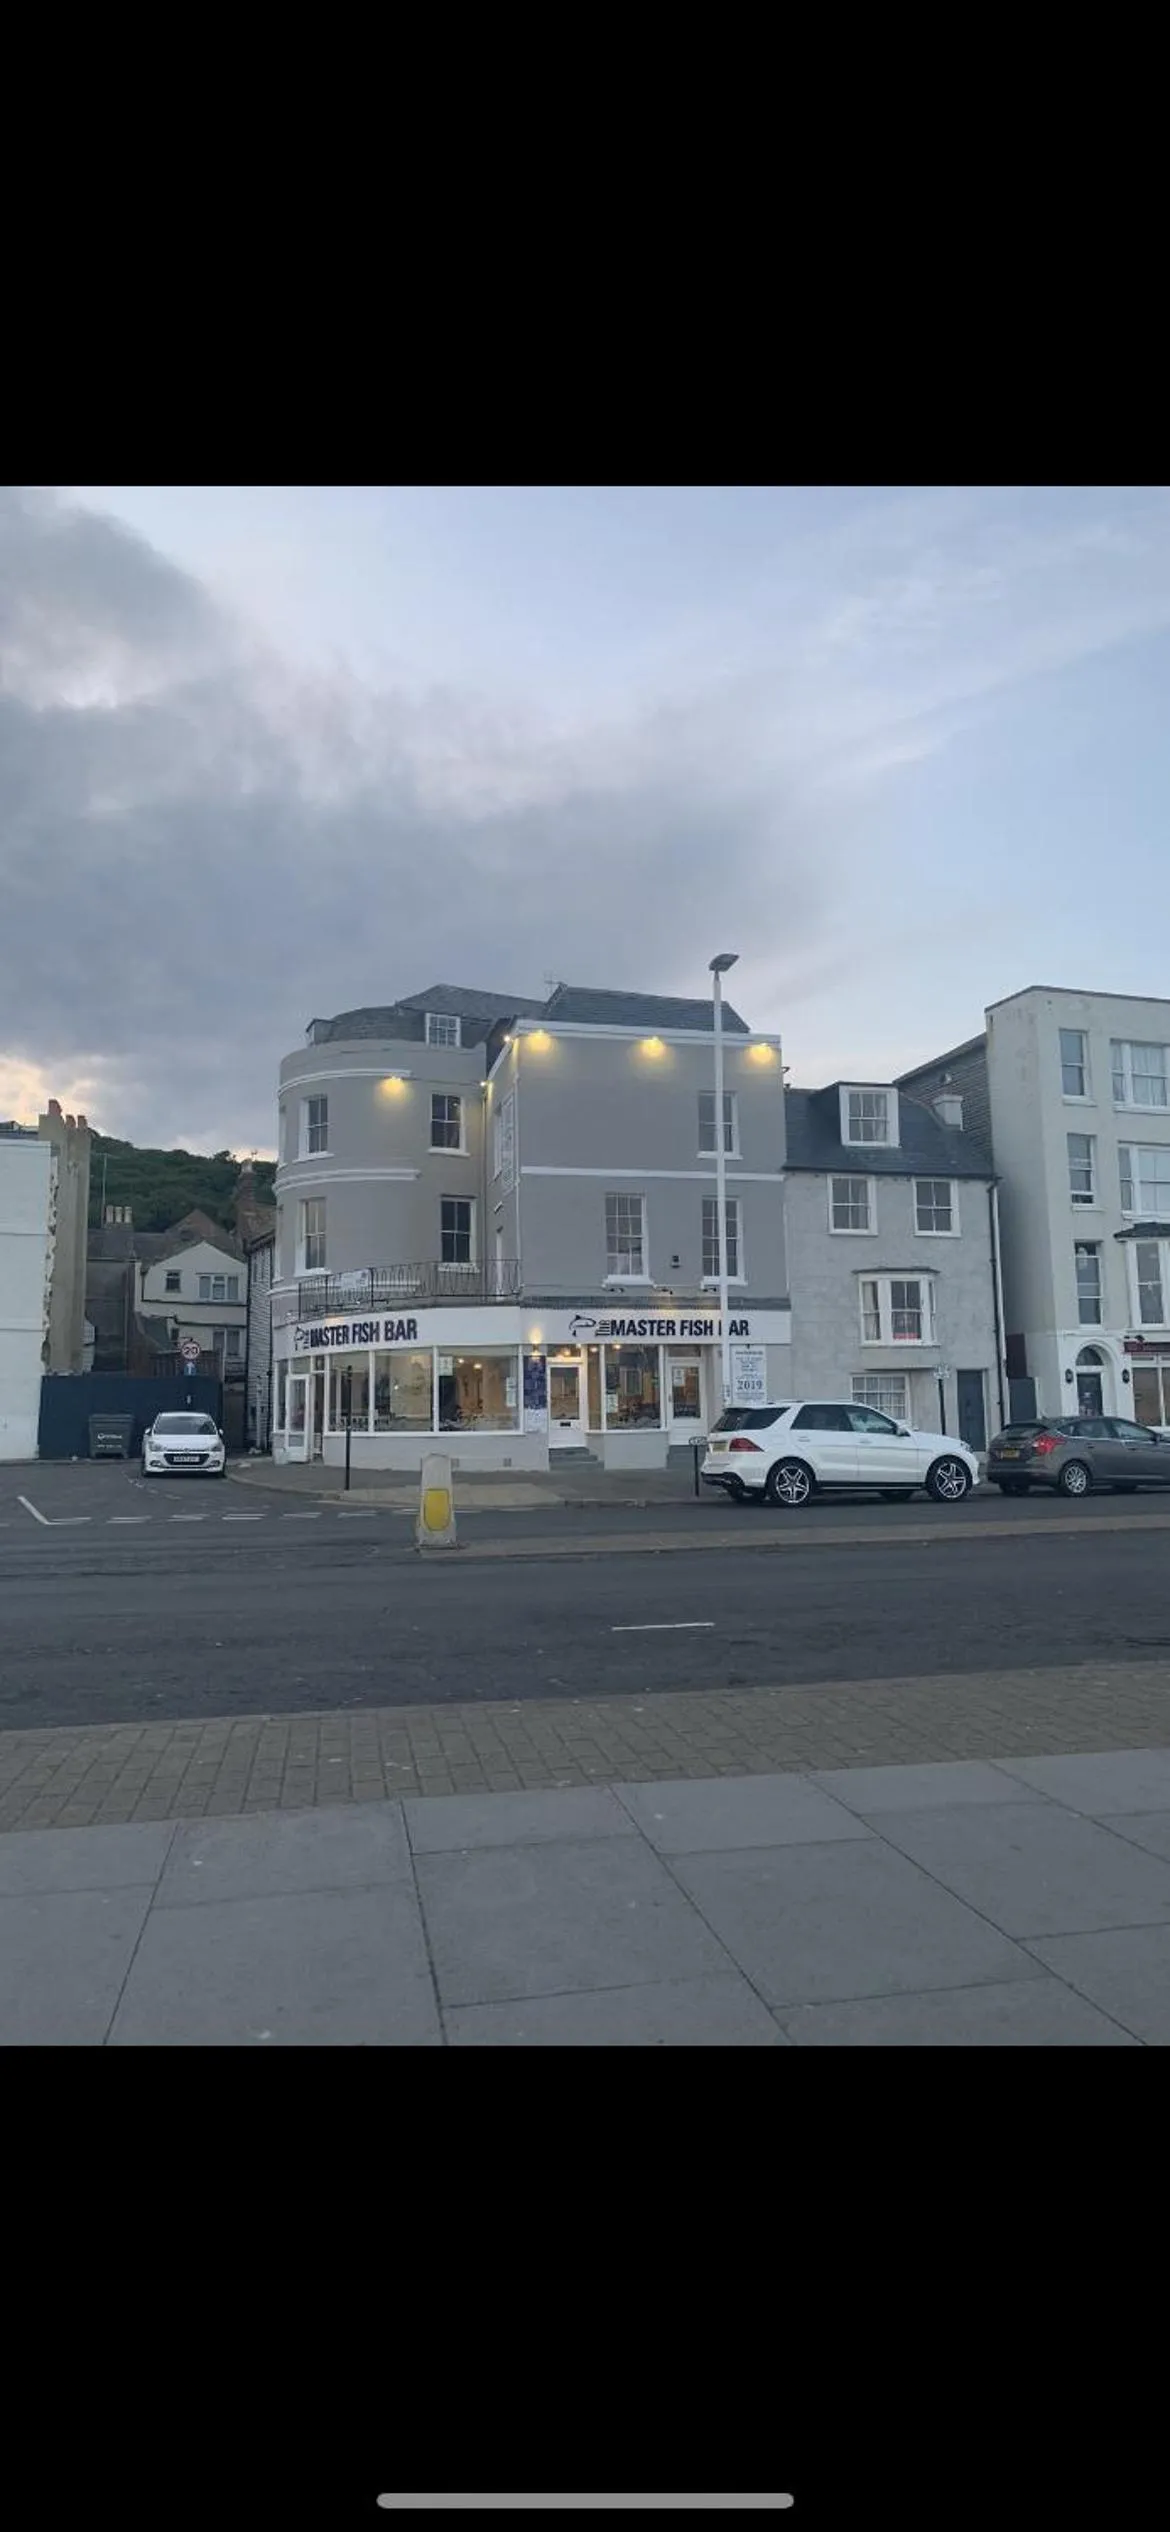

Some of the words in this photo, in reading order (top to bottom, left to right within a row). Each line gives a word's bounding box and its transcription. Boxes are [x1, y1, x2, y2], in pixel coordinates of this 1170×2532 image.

[310, 1325, 350, 1348] MASTER
[351, 1321, 380, 1344] FISH
[384, 1318, 418, 1341] BAR
[610, 1319, 676, 1336] MASTER
[679, 1319, 713, 1336] FISH
[718, 1319, 750, 1337] AR
[183, 1346, 198, 1355] 20
[736, 1380, 762, 1390] 2019
